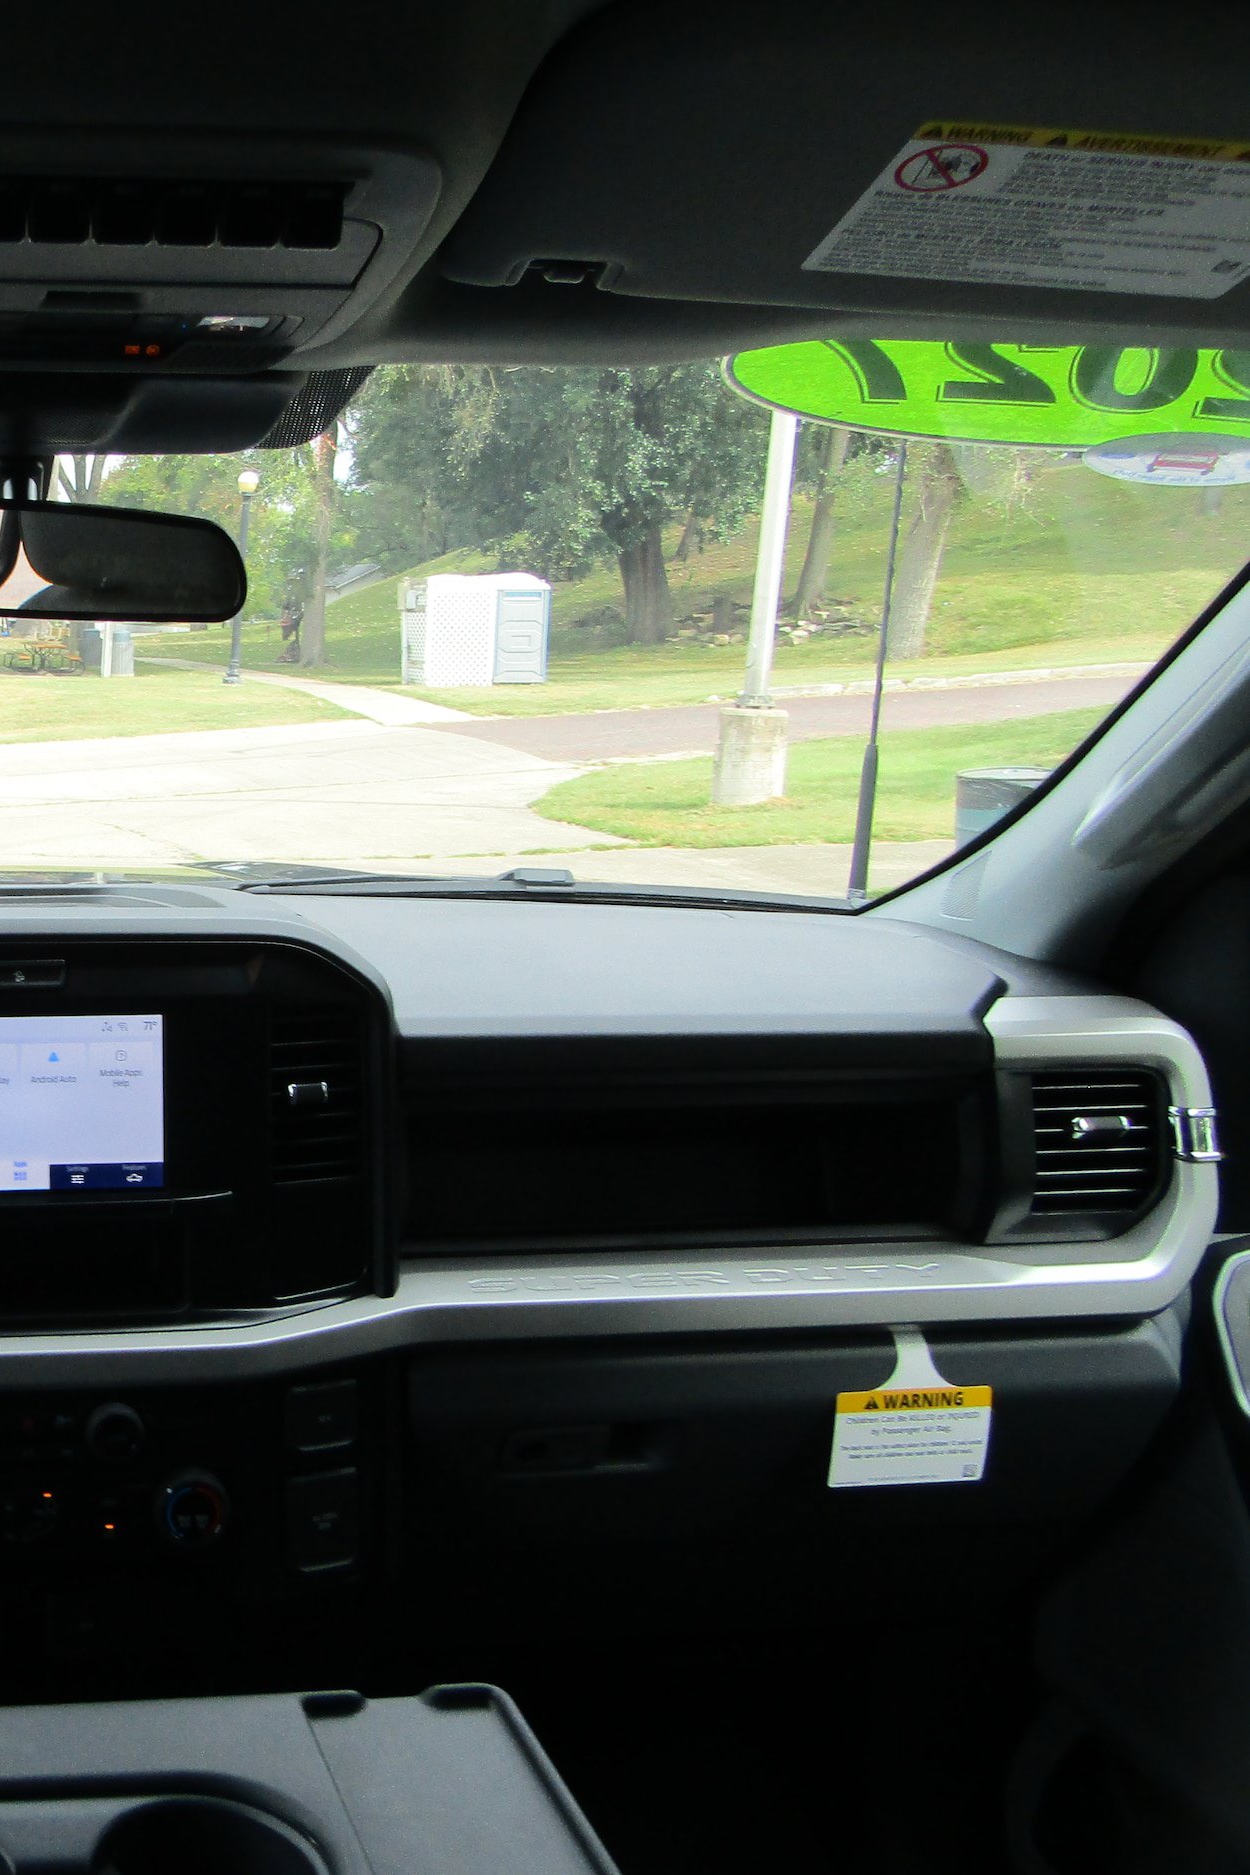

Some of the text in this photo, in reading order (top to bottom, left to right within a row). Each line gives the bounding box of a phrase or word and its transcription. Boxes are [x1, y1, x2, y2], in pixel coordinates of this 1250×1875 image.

[467, 1262, 941, 1294] SUPER DUTY
[883, 1391, 964, 1410] WARNING
